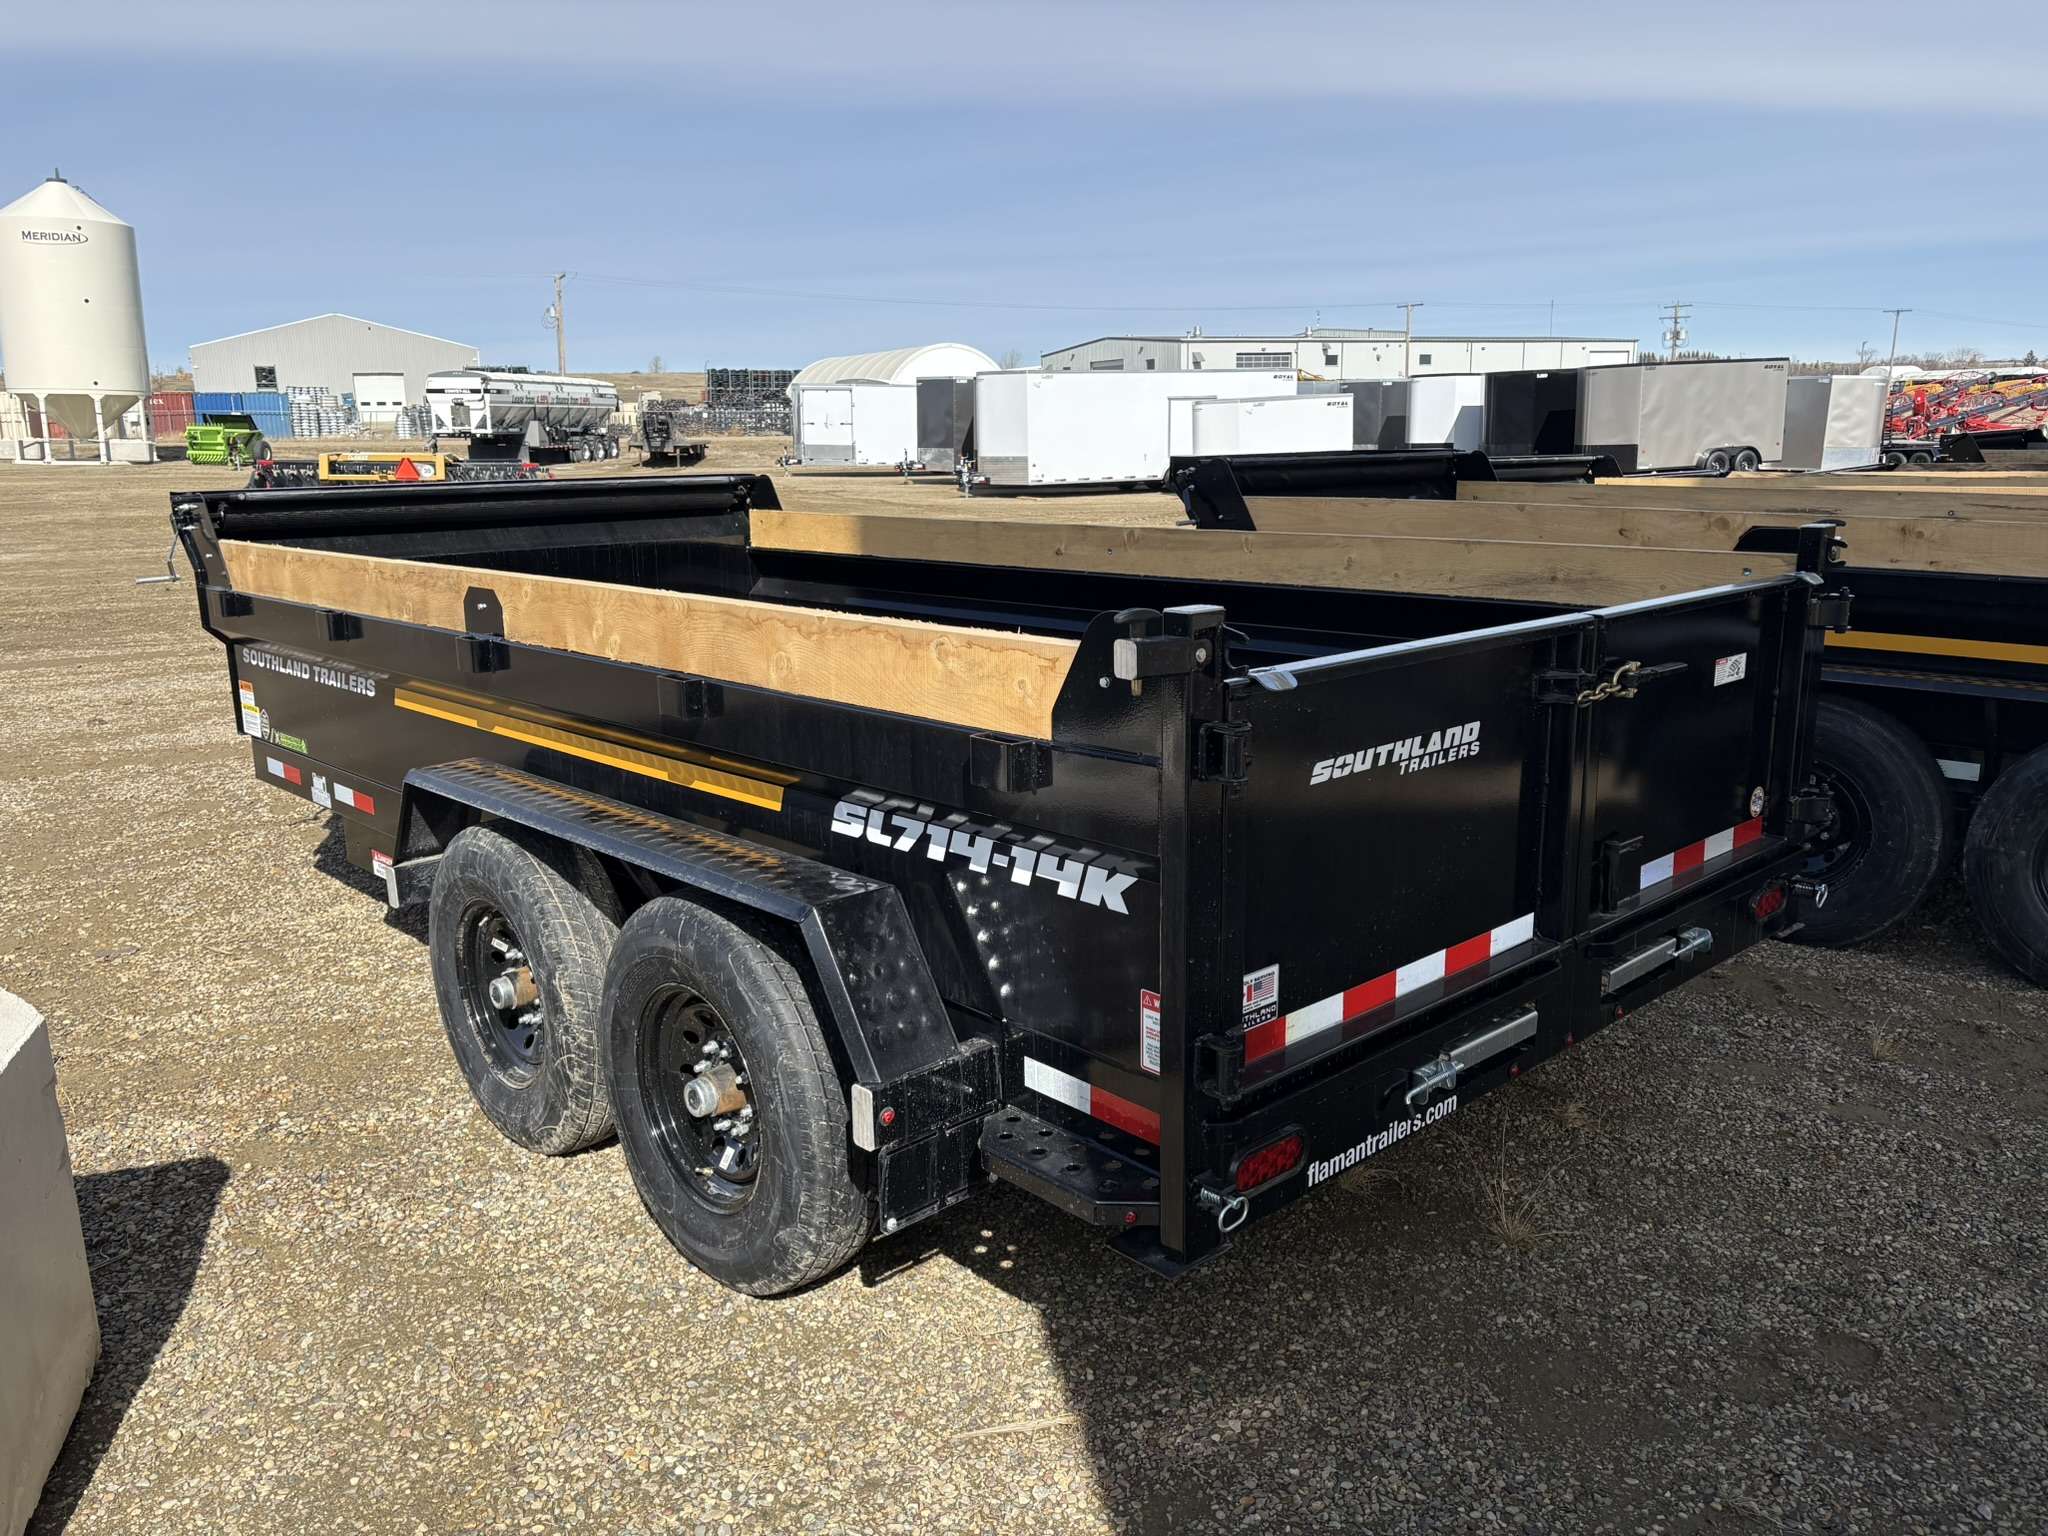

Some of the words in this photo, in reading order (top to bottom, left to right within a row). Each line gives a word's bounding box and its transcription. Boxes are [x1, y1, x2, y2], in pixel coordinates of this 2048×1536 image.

[21, 230, 81, 242] MERIDIAN
[242, 647, 310, 680] SOUTHLAND
[312, 665, 376, 698] TRAILERS
[1310, 720, 1481, 785] SOUTHLAND
[1399, 741, 1480, 775] TRAILERS
[830, 800, 1138, 915] SL714-14K
[1306, 1095, 1458, 1188] flamantrailers.com
